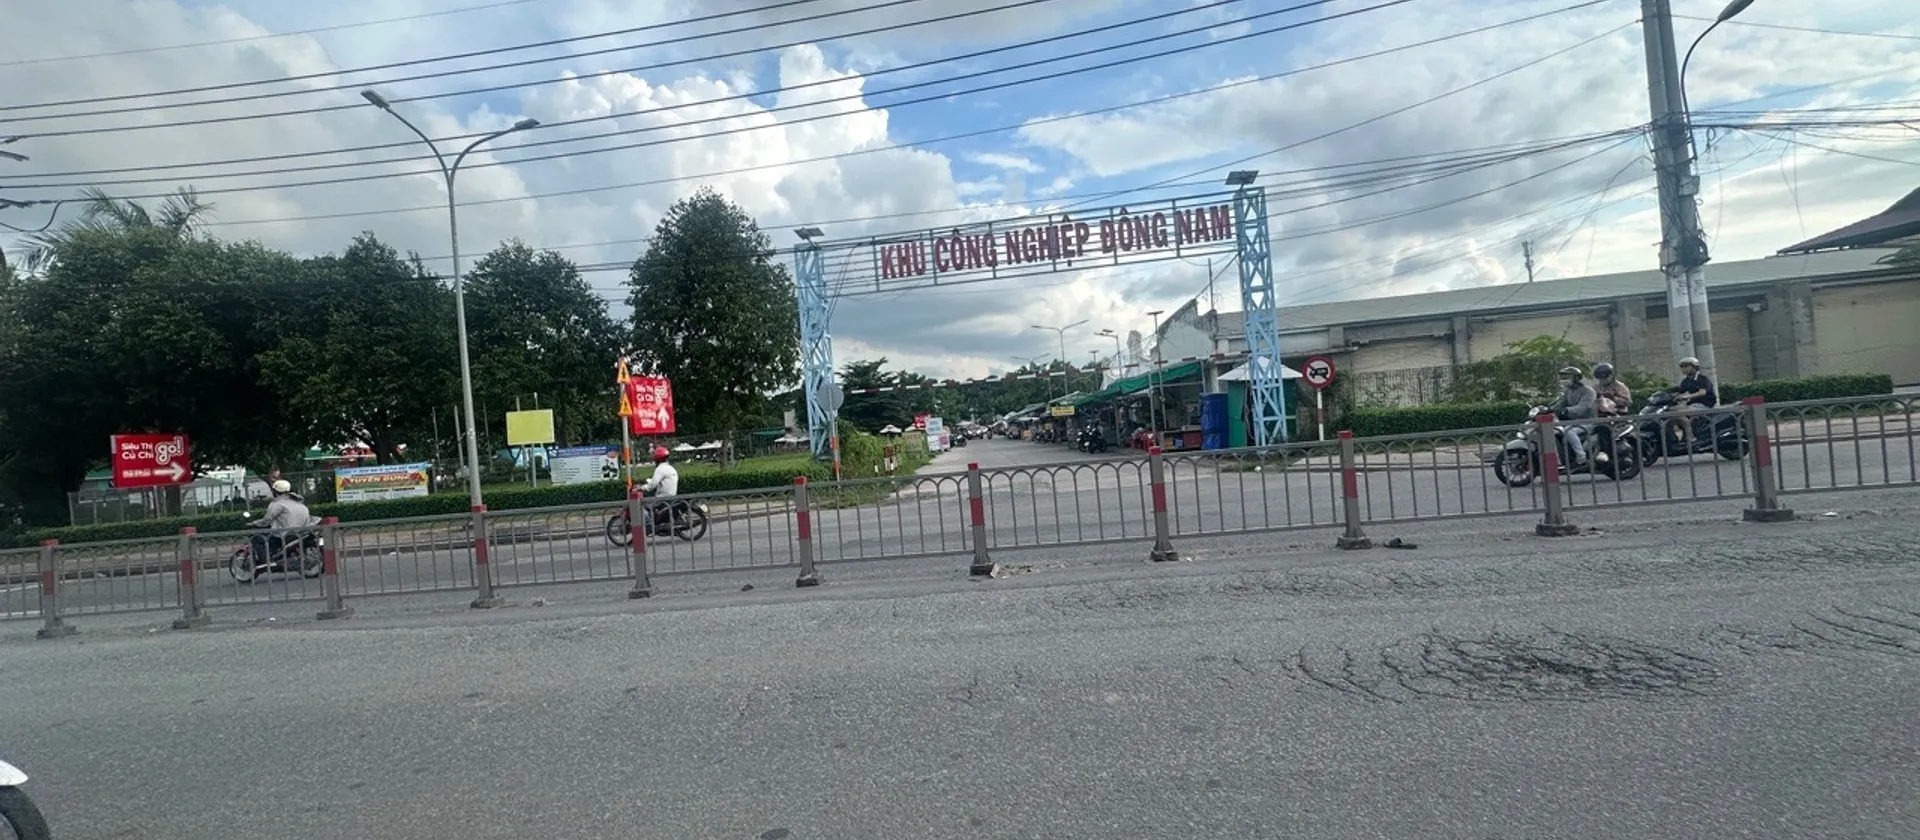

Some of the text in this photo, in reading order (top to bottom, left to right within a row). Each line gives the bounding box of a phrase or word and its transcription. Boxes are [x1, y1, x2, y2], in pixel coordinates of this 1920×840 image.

[880, 204, 1232, 279] KHU CÔNG NGHIỆP ĐÔNG NAM
[156, 436, 183, 464] go!
